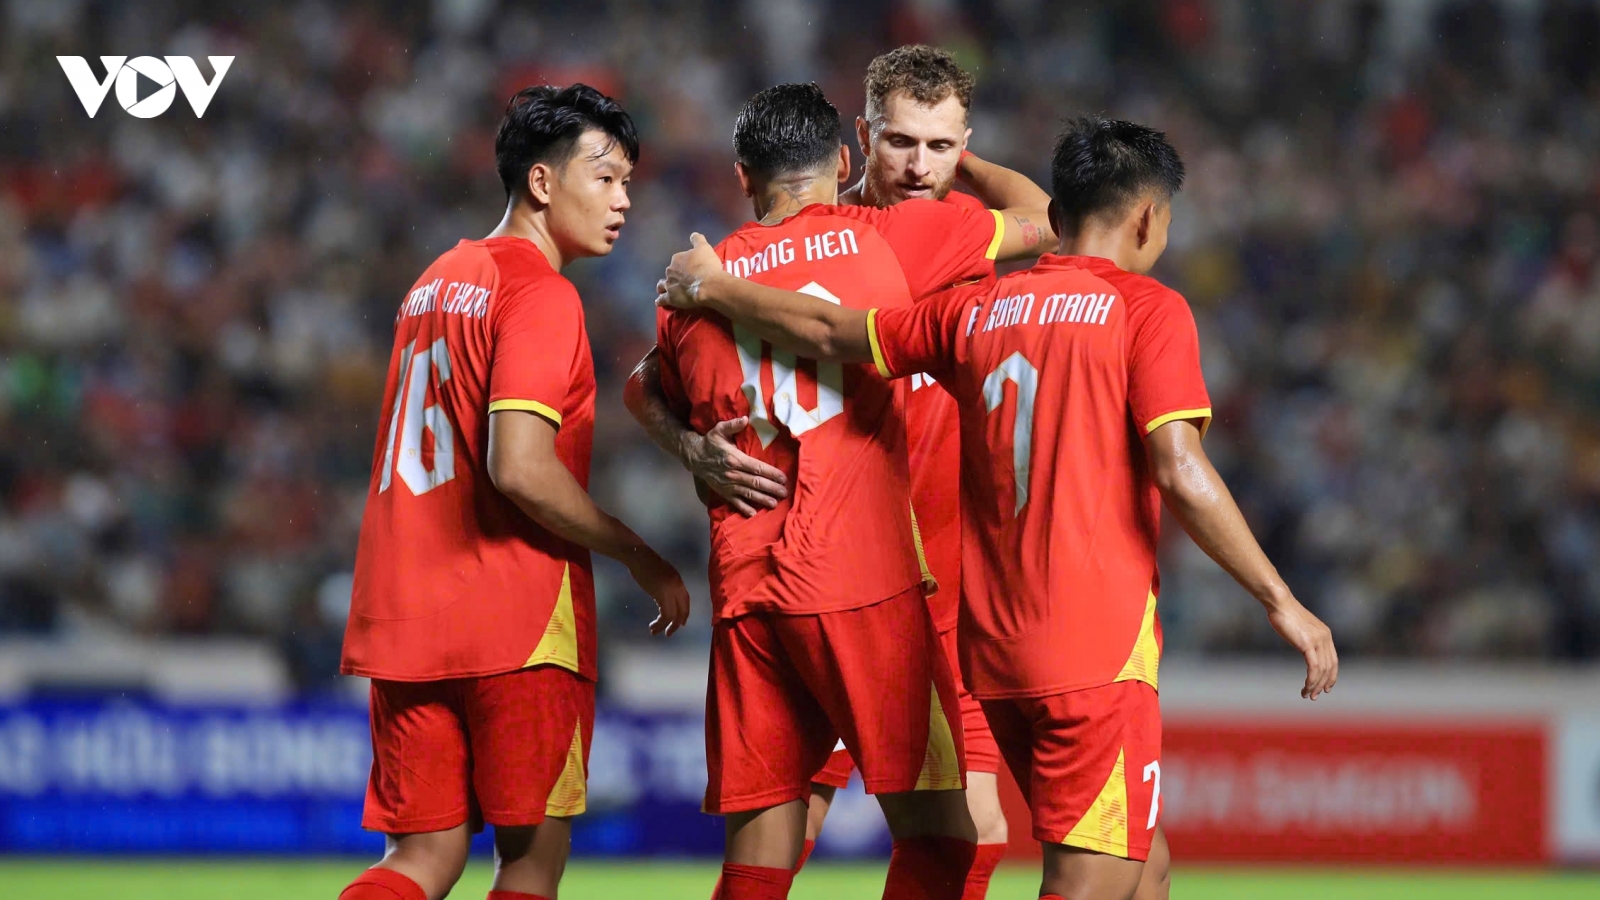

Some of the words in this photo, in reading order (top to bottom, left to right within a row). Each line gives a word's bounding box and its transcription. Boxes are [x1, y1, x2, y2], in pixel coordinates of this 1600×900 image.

[804, 228, 859, 262] HEN
[1038, 293, 1116, 325] MANH
[378, 336, 456, 496] 16
[982, 351, 1038, 518] 7
[1142, 760, 1160, 830] 7
